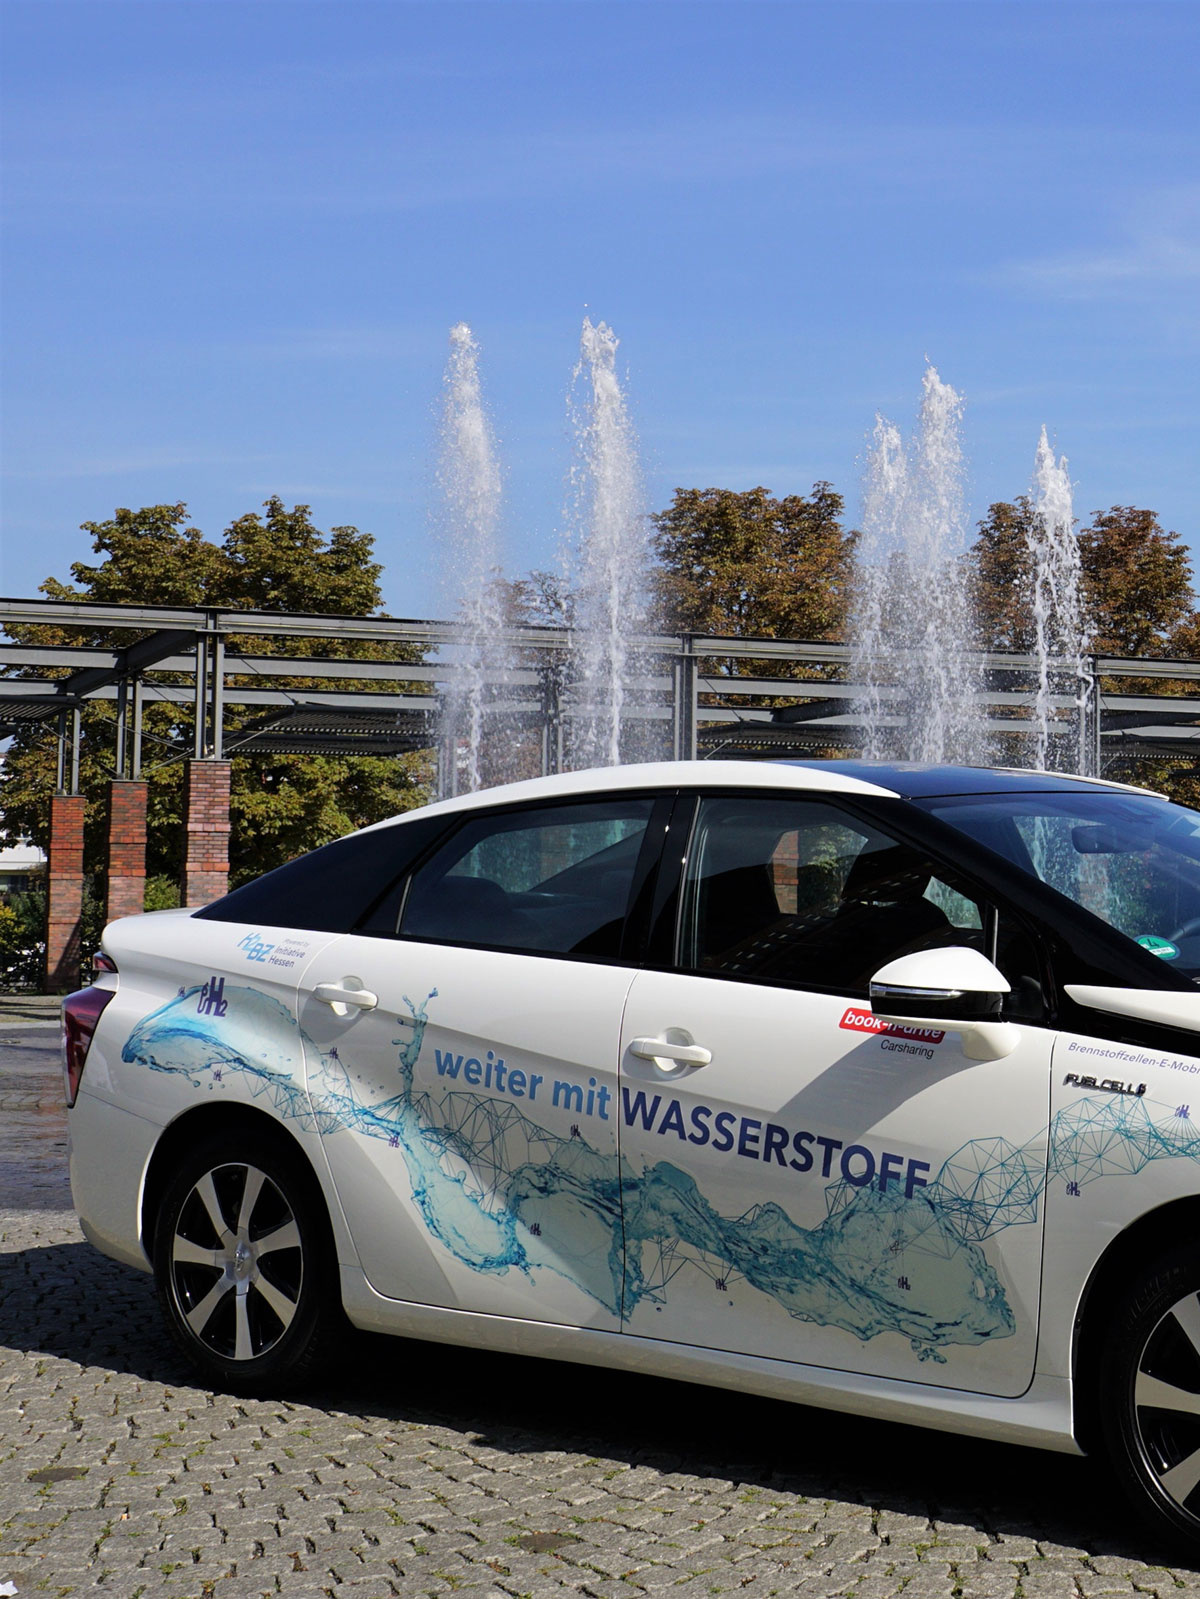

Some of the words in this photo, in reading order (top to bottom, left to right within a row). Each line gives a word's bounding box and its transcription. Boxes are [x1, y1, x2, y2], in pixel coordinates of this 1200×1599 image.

[274, 946, 306, 958] Initiative
[268, 955, 295, 968] Hessen
[880, 1039, 934, 1060] Carsharing
[434, 1049, 543, 1100] weiter
[552, 1077, 611, 1120] mit
[621, 1087, 931, 1199] WASSERSTOFF
